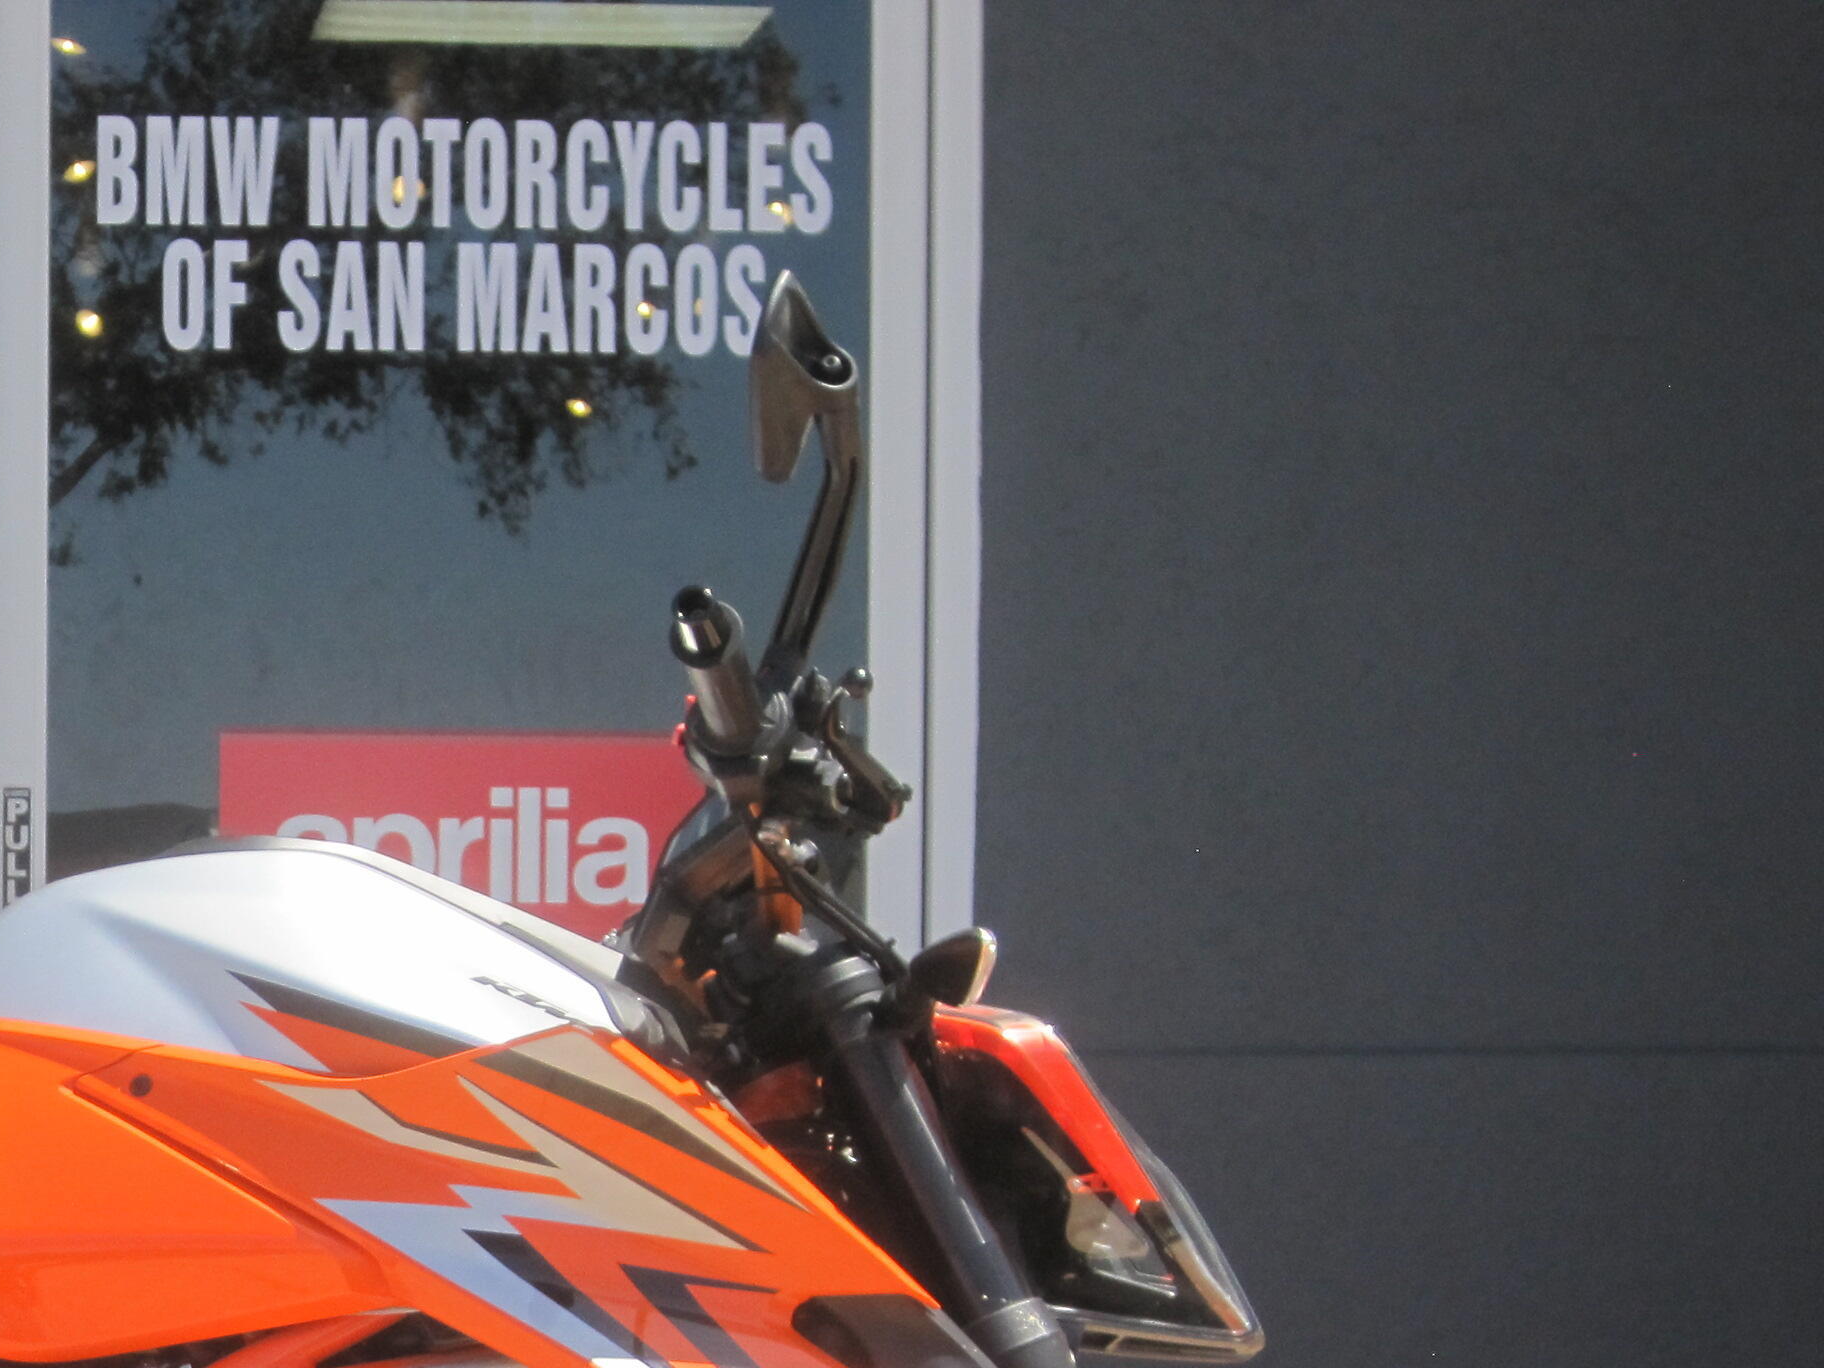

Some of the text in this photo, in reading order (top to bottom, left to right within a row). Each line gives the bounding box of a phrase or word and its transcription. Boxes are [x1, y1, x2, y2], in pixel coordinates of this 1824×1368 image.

[96, 114, 834, 235] BMW MOTORCYCLES
[161, 237, 766, 357] OF SAN MARCOS
[277, 786, 650, 905] rilia
